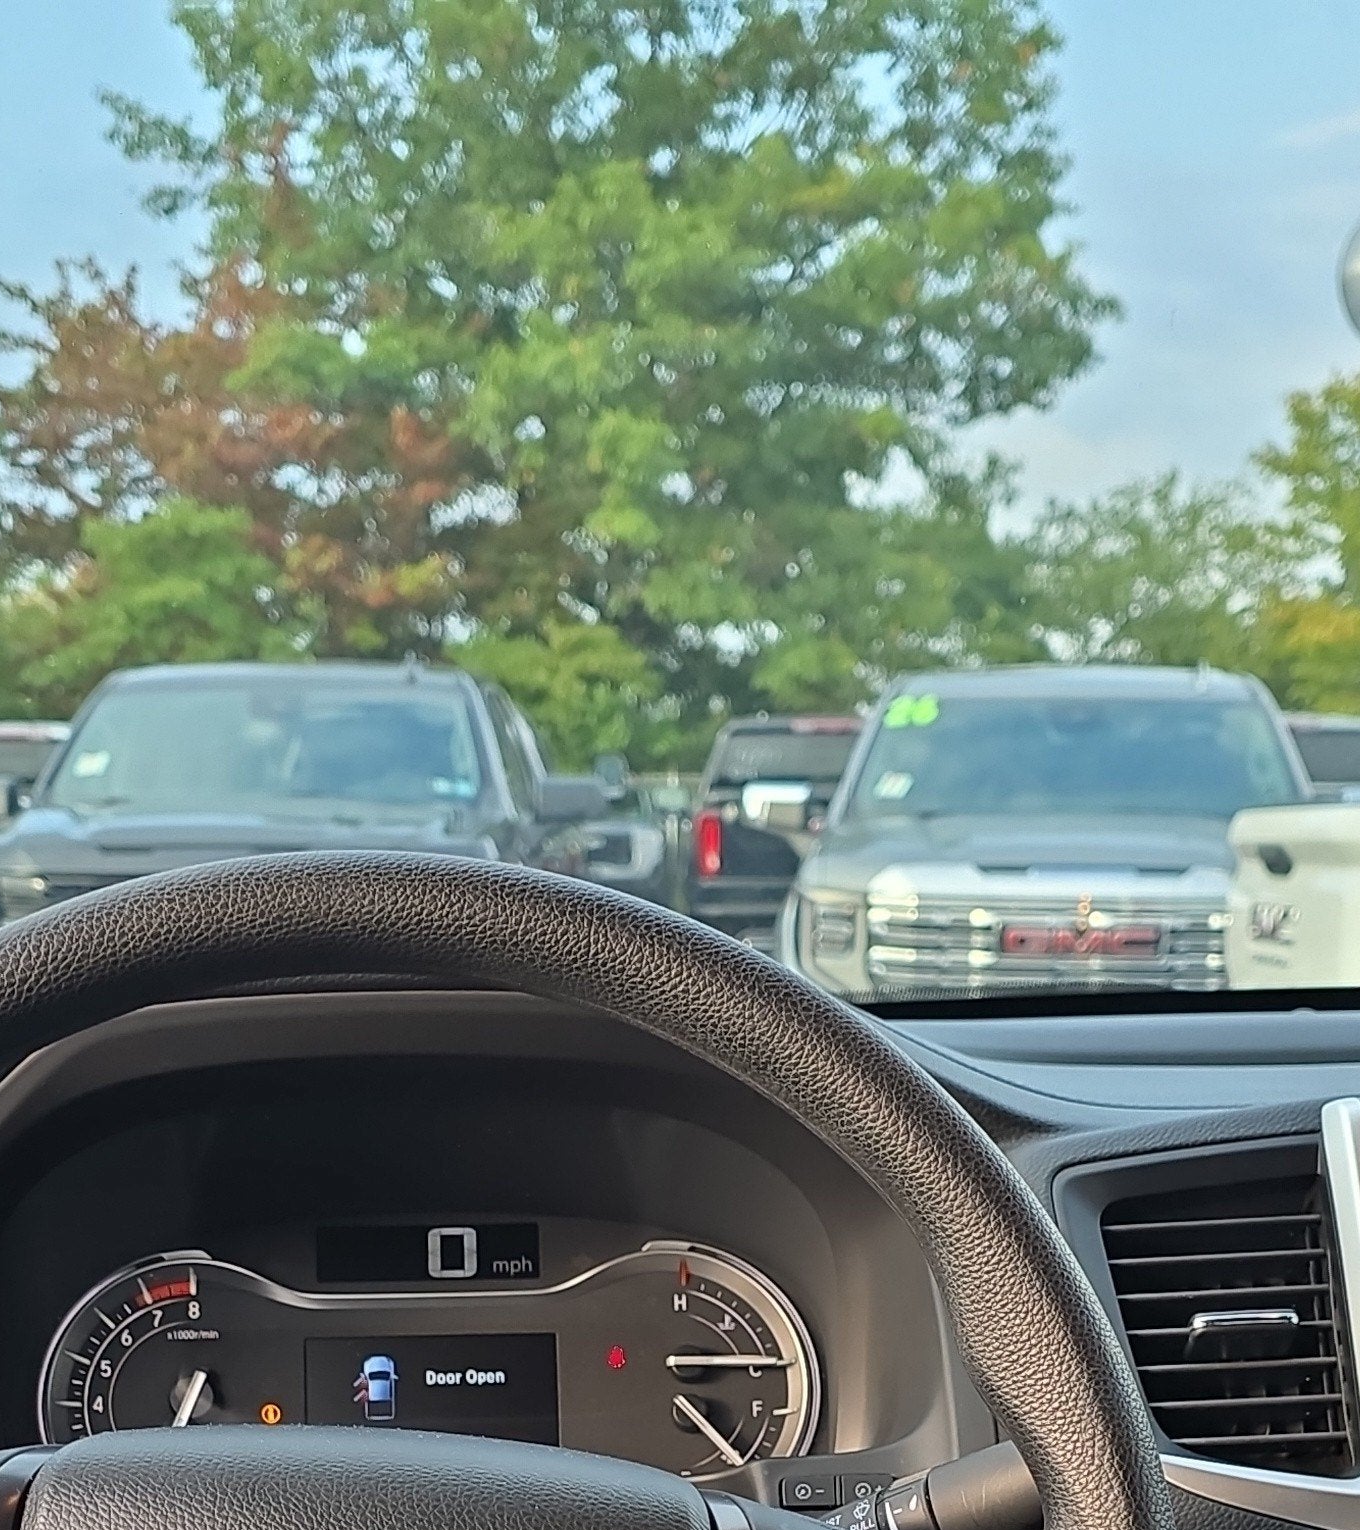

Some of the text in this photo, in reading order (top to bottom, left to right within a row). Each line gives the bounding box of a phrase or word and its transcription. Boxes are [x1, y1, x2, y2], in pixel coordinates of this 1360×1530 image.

[428, 1227, 533, 1278] 0 mph
[188, 1301, 201, 1320] 8
[673, 1293, 687, 1312] H
[152, 1309, 163, 1327] 7
[120, 1329, 133, 1346] 6
[100, 1359, 111, 1378] 5
[425, 1369, 505, 1386] Door Open
[92, 1396, 103, 1413] 4
[752, 1400, 763, 1417] F
